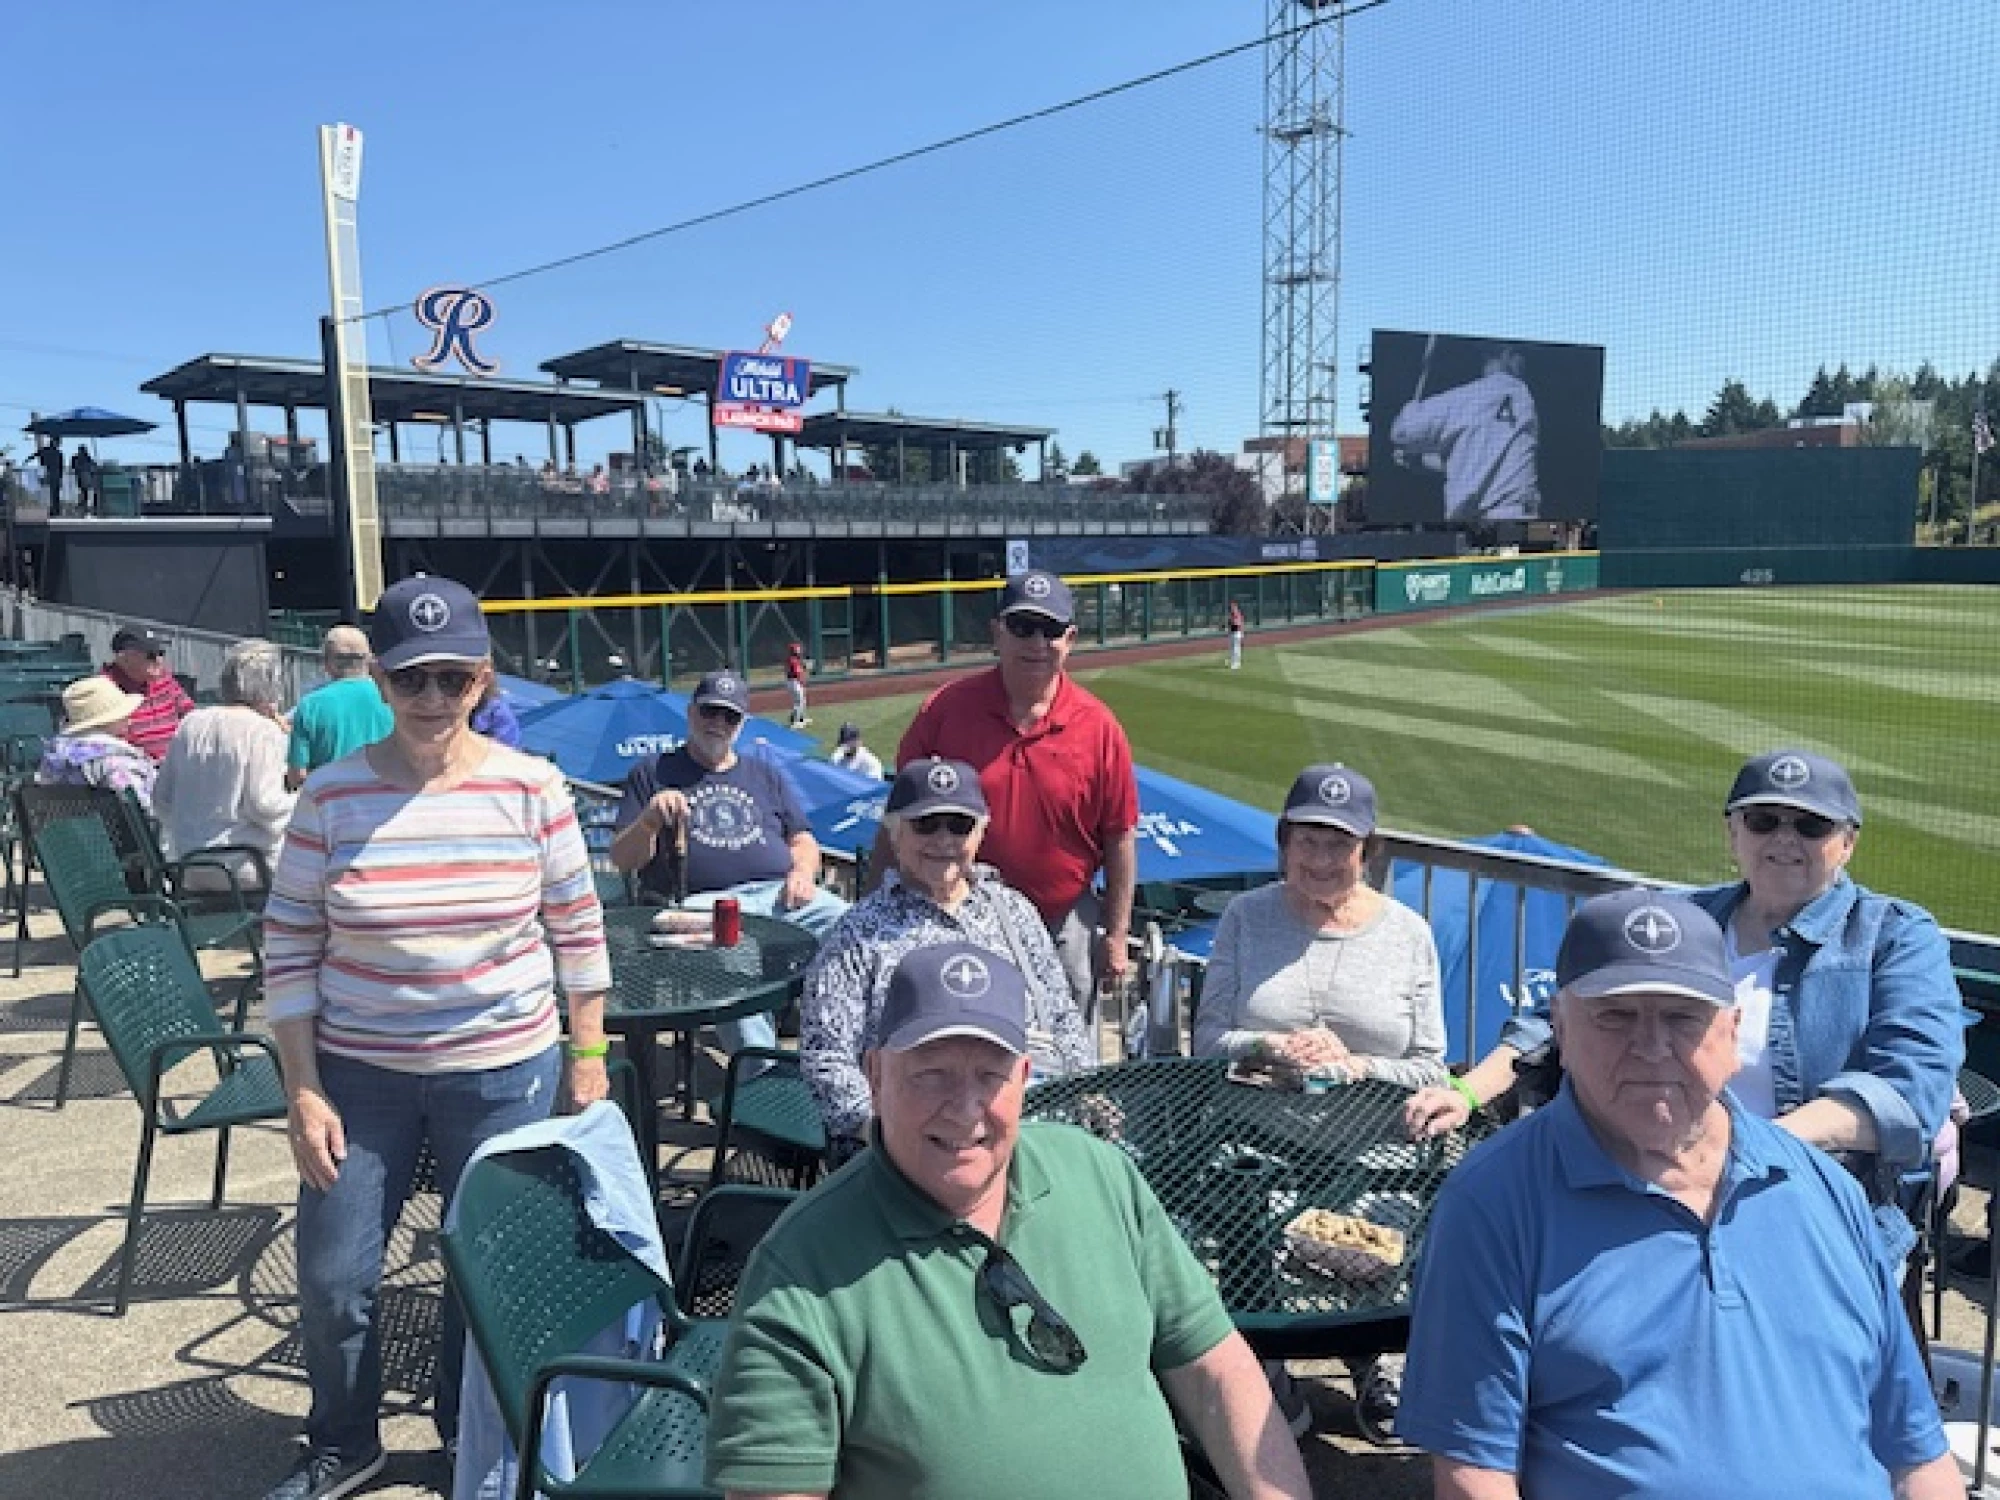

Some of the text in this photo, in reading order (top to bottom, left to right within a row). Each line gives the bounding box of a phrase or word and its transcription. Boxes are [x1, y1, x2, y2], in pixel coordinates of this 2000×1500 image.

[410, 284, 500, 377] R
[730, 377, 799, 402] ULTRA
[1496, 394, 1517, 428] 4
